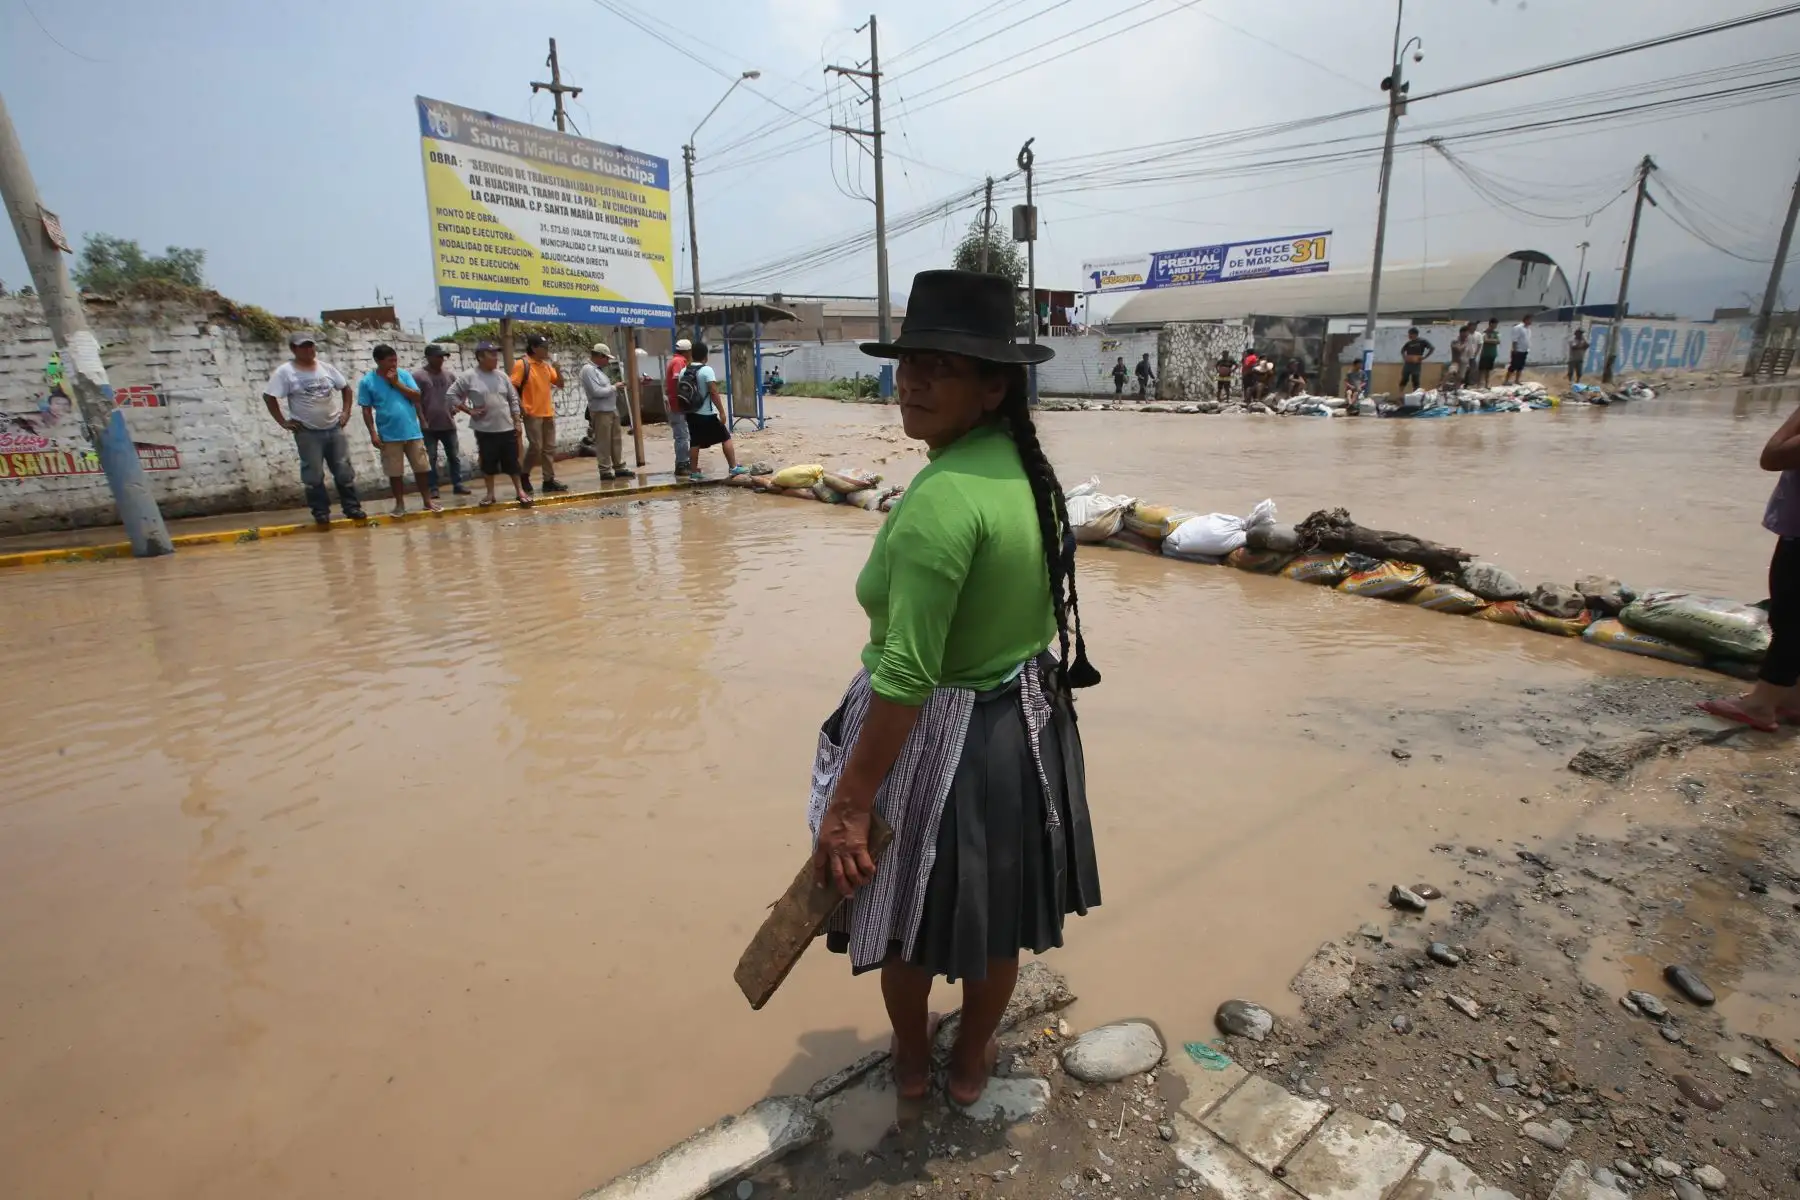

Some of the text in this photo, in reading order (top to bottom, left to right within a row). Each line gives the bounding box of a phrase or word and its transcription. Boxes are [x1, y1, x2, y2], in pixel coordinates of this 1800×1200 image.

[470, 126, 520, 152] Santa
[571, 152, 589, 169] de
[593, 155, 656, 186] Huachipa
[515, 167, 526, 181] DE
[527, 170, 594, 193] TRANSITABILIDAD
[469, 174, 484, 187] AV.
[532, 186, 560, 201] TRAMO
[574, 194, 583, 205] LA
[584, 196, 597, 208] PAZ
[470, 190, 482, 202] LA
[529, 200, 543, 212] C.P.
[544, 203, 569, 217] SANTA
[570, 207, 594, 220] MARÍA
[595, 212, 604, 222] DE
[436, 207, 499, 224] MONTO DE OBRA:
[438, 223, 515, 241] ENTIDAD EJECUTORA:
[592, 230, 609, 241] TOTAL
[610, 233, 617, 242] DE
[618, 234, 626, 243] LA
[439, 239, 482, 252] MODALIDAD
[484, 244, 493, 253] DE
[540, 238, 586, 251] MUNICIPALIDAD
[598, 245, 616, 255] SANTA
[633, 250, 640, 258] DE
[641, 252, 665, 262] HUACHIPA
[1245, 243, 1291, 257] VENCE
[1290, 237, 1327, 263] 31
[441, 254, 465, 264] PLAZO
[469, 257, 478, 266] DE
[585, 257, 609, 267] DIRECTA
[1158, 254, 1220, 270] PREDIAL
[1229, 254, 1290, 269] DE MARZO
[542, 266, 550, 274] 30
[566, 268, 605, 280] CALENDARIOS
[1159, 268, 1165, 276] Y
[1168, 263, 1220, 275] ARBITRIOS
[1171, 271, 1206, 283] 2017
[442, 269, 531, 286] FTE. DE FINANCIAMIENTO:
[1101, 273, 1144, 285] CUOTA
[542, 280, 600, 293] RECURSOS PROPIOS
[450, 294, 504, 314] Trabajando
[504, 304, 519, 315] por
[520, 302, 528, 313] el
[590, 304, 672, 318] ROGELIO RUIZ PORTOCARRERO
[620, 316, 645, 325] ALCALDE
[1585, 323, 1708, 375] ROGELIO
